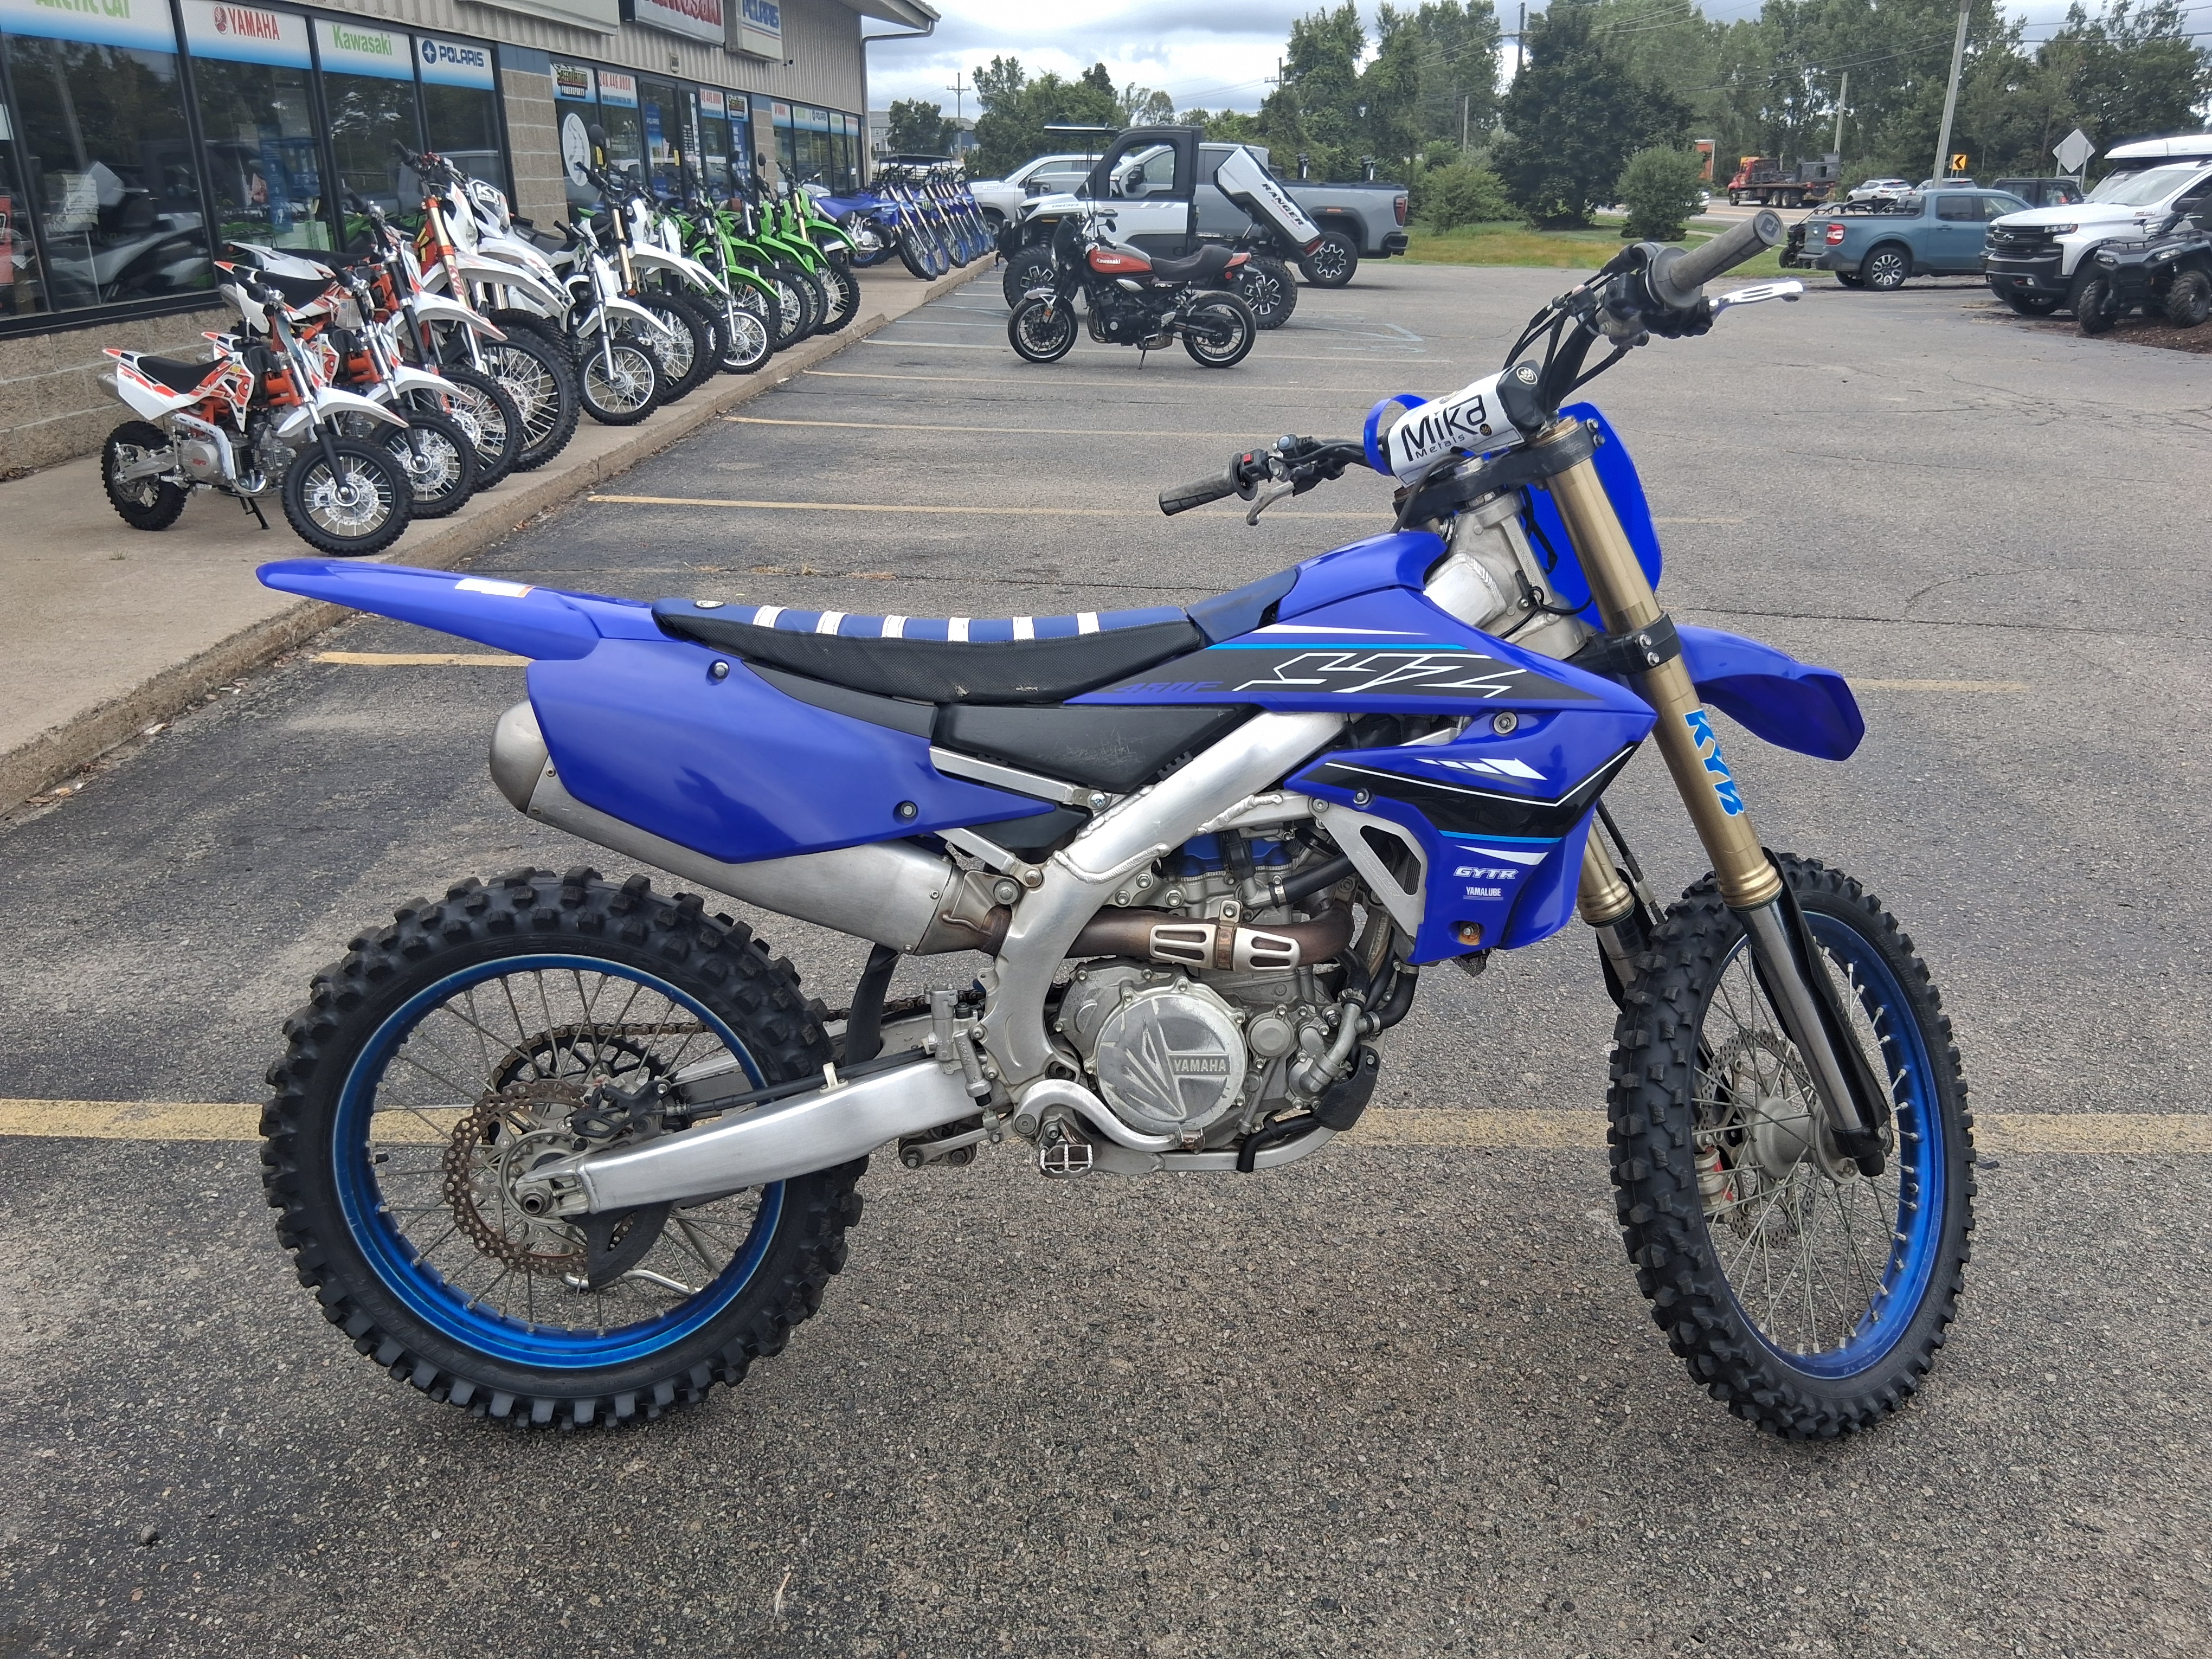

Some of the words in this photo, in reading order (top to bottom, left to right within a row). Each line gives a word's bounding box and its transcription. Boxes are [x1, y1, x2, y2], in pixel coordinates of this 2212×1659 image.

[227, 7, 280, 40] YAMAHA
[332, 24, 393, 56] Kawasaki
[440, 45, 484, 68] POLARIS
[476, 184, 500, 200] KT
[1262, 184, 1304, 226] RANGER
[1414, 434, 1465, 459] Metals
[1683, 708, 1745, 816] KYB
[1453, 866, 1519, 879] GYTR
[1465, 886, 1502, 897] YAMALUBE
[1173, 1058, 1227, 1072] YAMAHA
